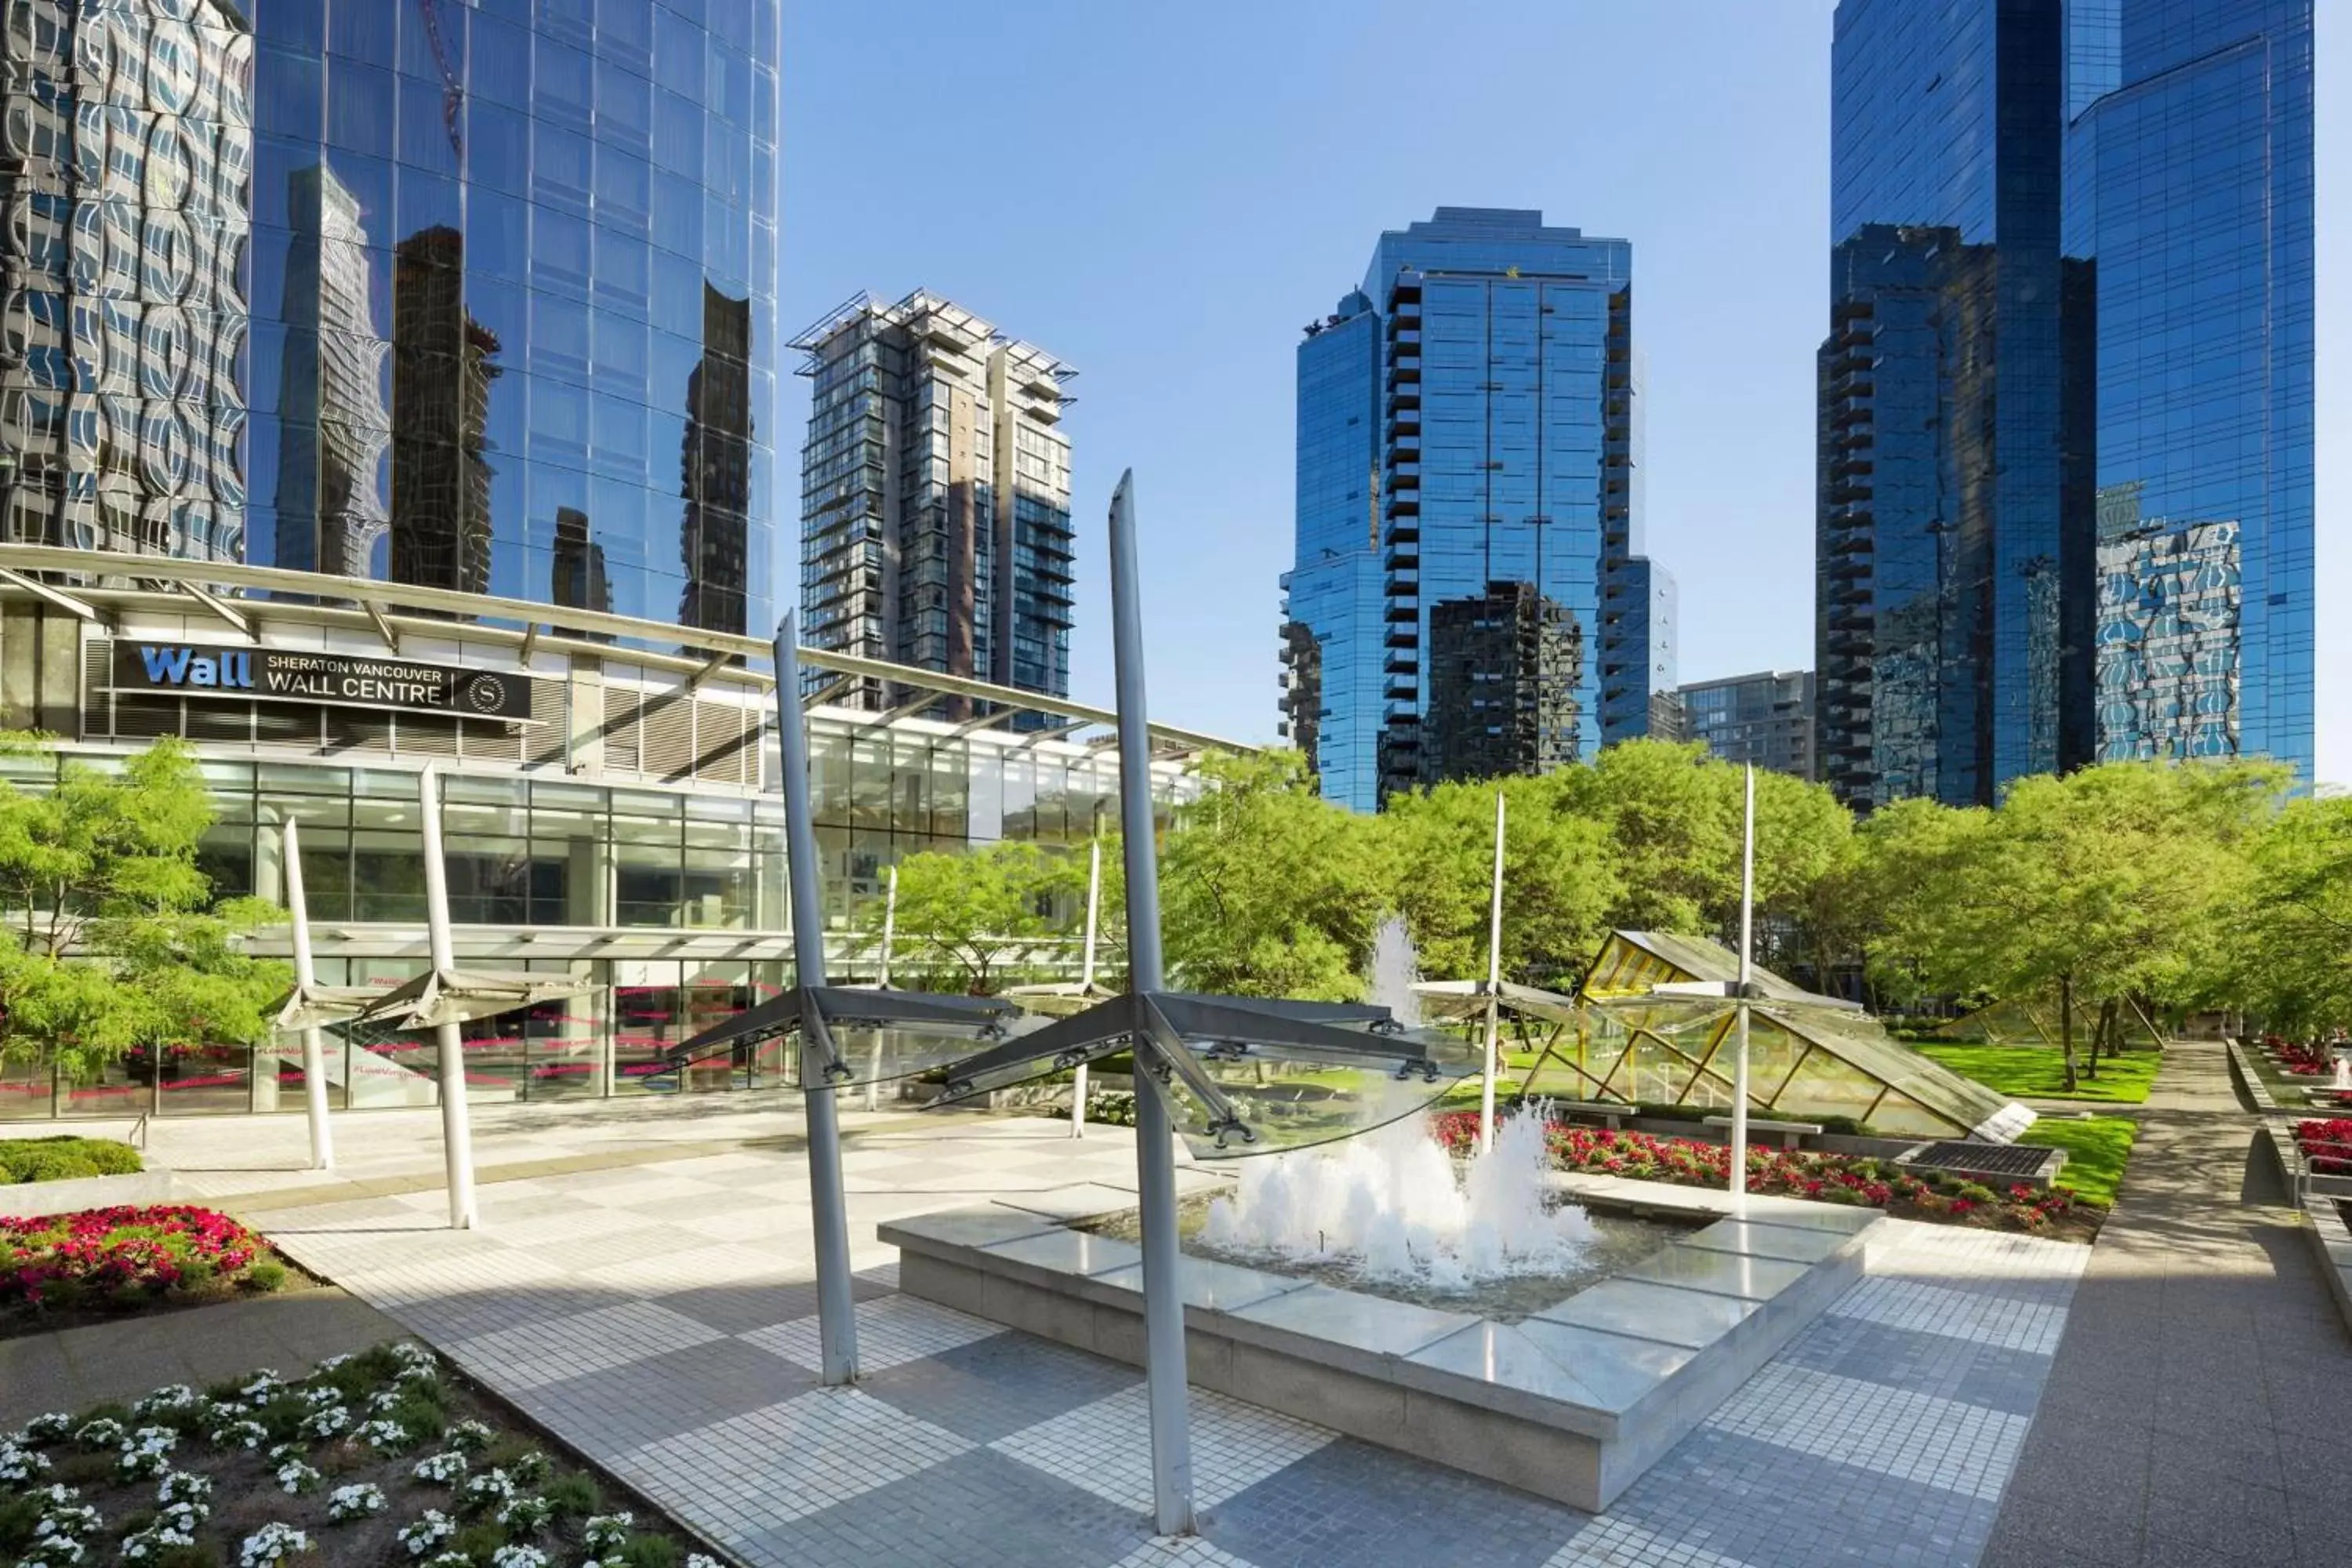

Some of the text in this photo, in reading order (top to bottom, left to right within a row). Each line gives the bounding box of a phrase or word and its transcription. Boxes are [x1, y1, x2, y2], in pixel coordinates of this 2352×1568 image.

[140, 646, 253, 688] Wall
[267, 655, 442, 683] SHERATON VANCOUVER
[267, 672, 442, 705] WALL CENTRE
